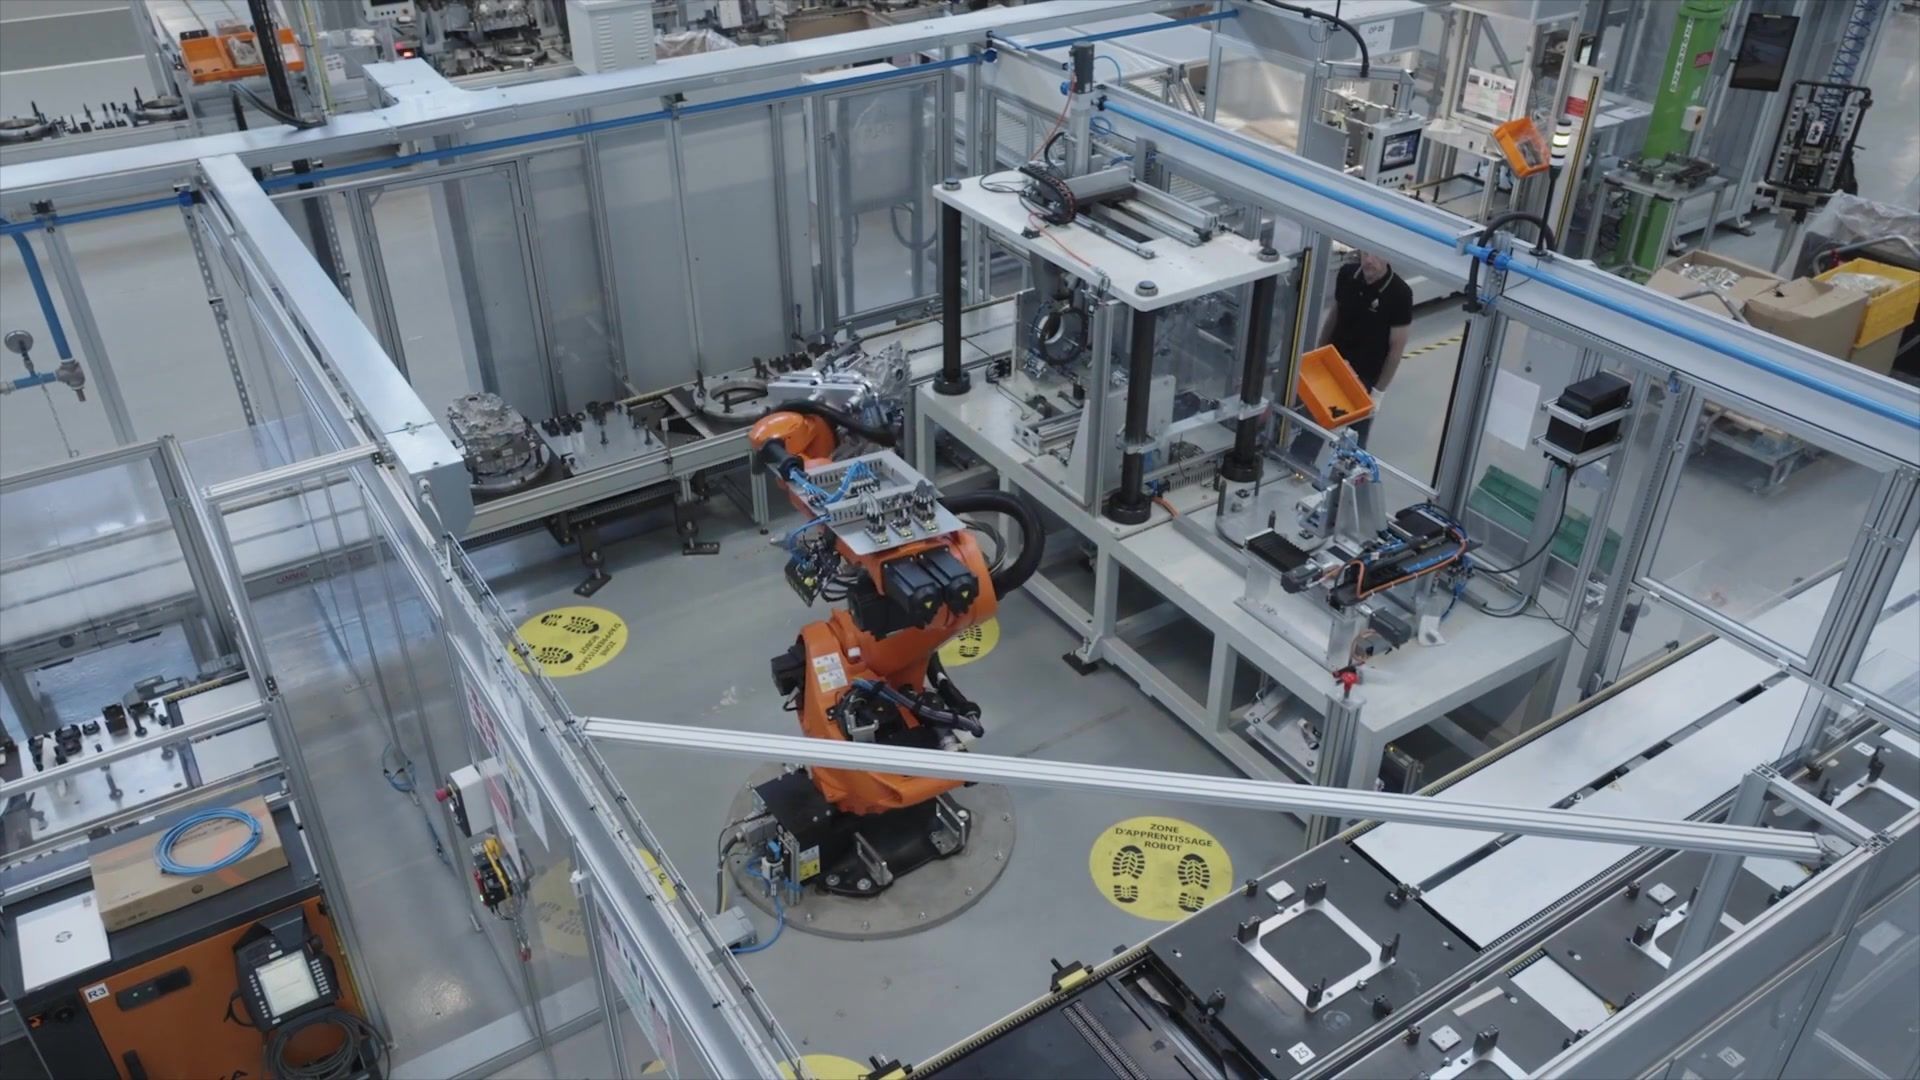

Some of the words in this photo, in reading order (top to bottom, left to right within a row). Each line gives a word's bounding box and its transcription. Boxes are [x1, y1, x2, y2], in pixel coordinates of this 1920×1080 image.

[1150, 823, 1180, 834] ZONE
[1115, 827, 1213, 847] D'APPRENTISSAGE
[1144, 840, 1182, 851] ROBOT
[87, 986, 106, 999] R3
[1294, 1046, 1309, 1060] 25
